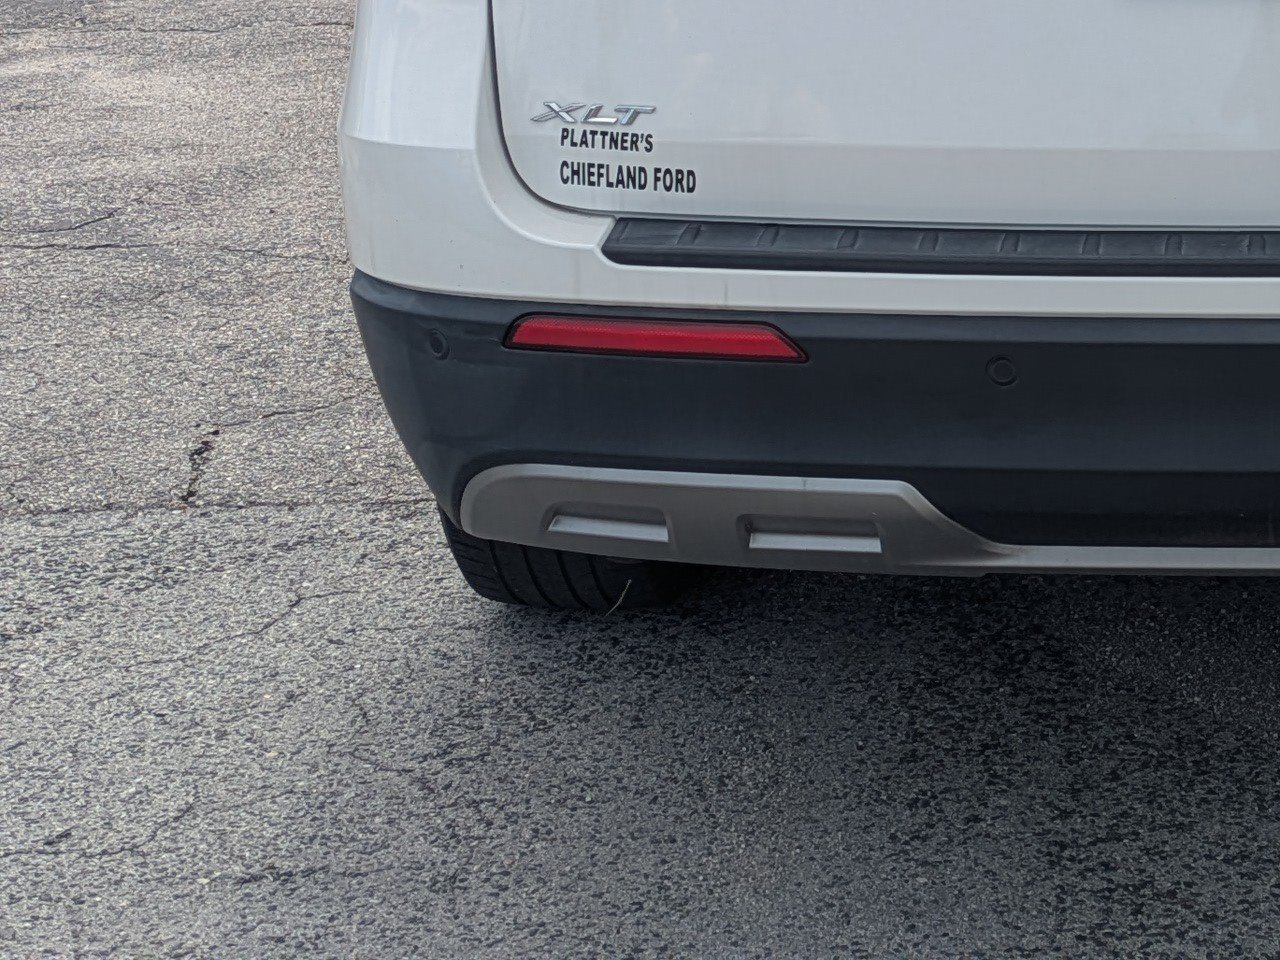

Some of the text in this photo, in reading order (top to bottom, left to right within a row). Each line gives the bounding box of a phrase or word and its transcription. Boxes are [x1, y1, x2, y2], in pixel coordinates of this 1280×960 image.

[530, 102, 656, 125] XLT
[560, 127, 654, 153] PLATTNER'S
[559, 160, 697, 193] CHIEFLAND FORD
